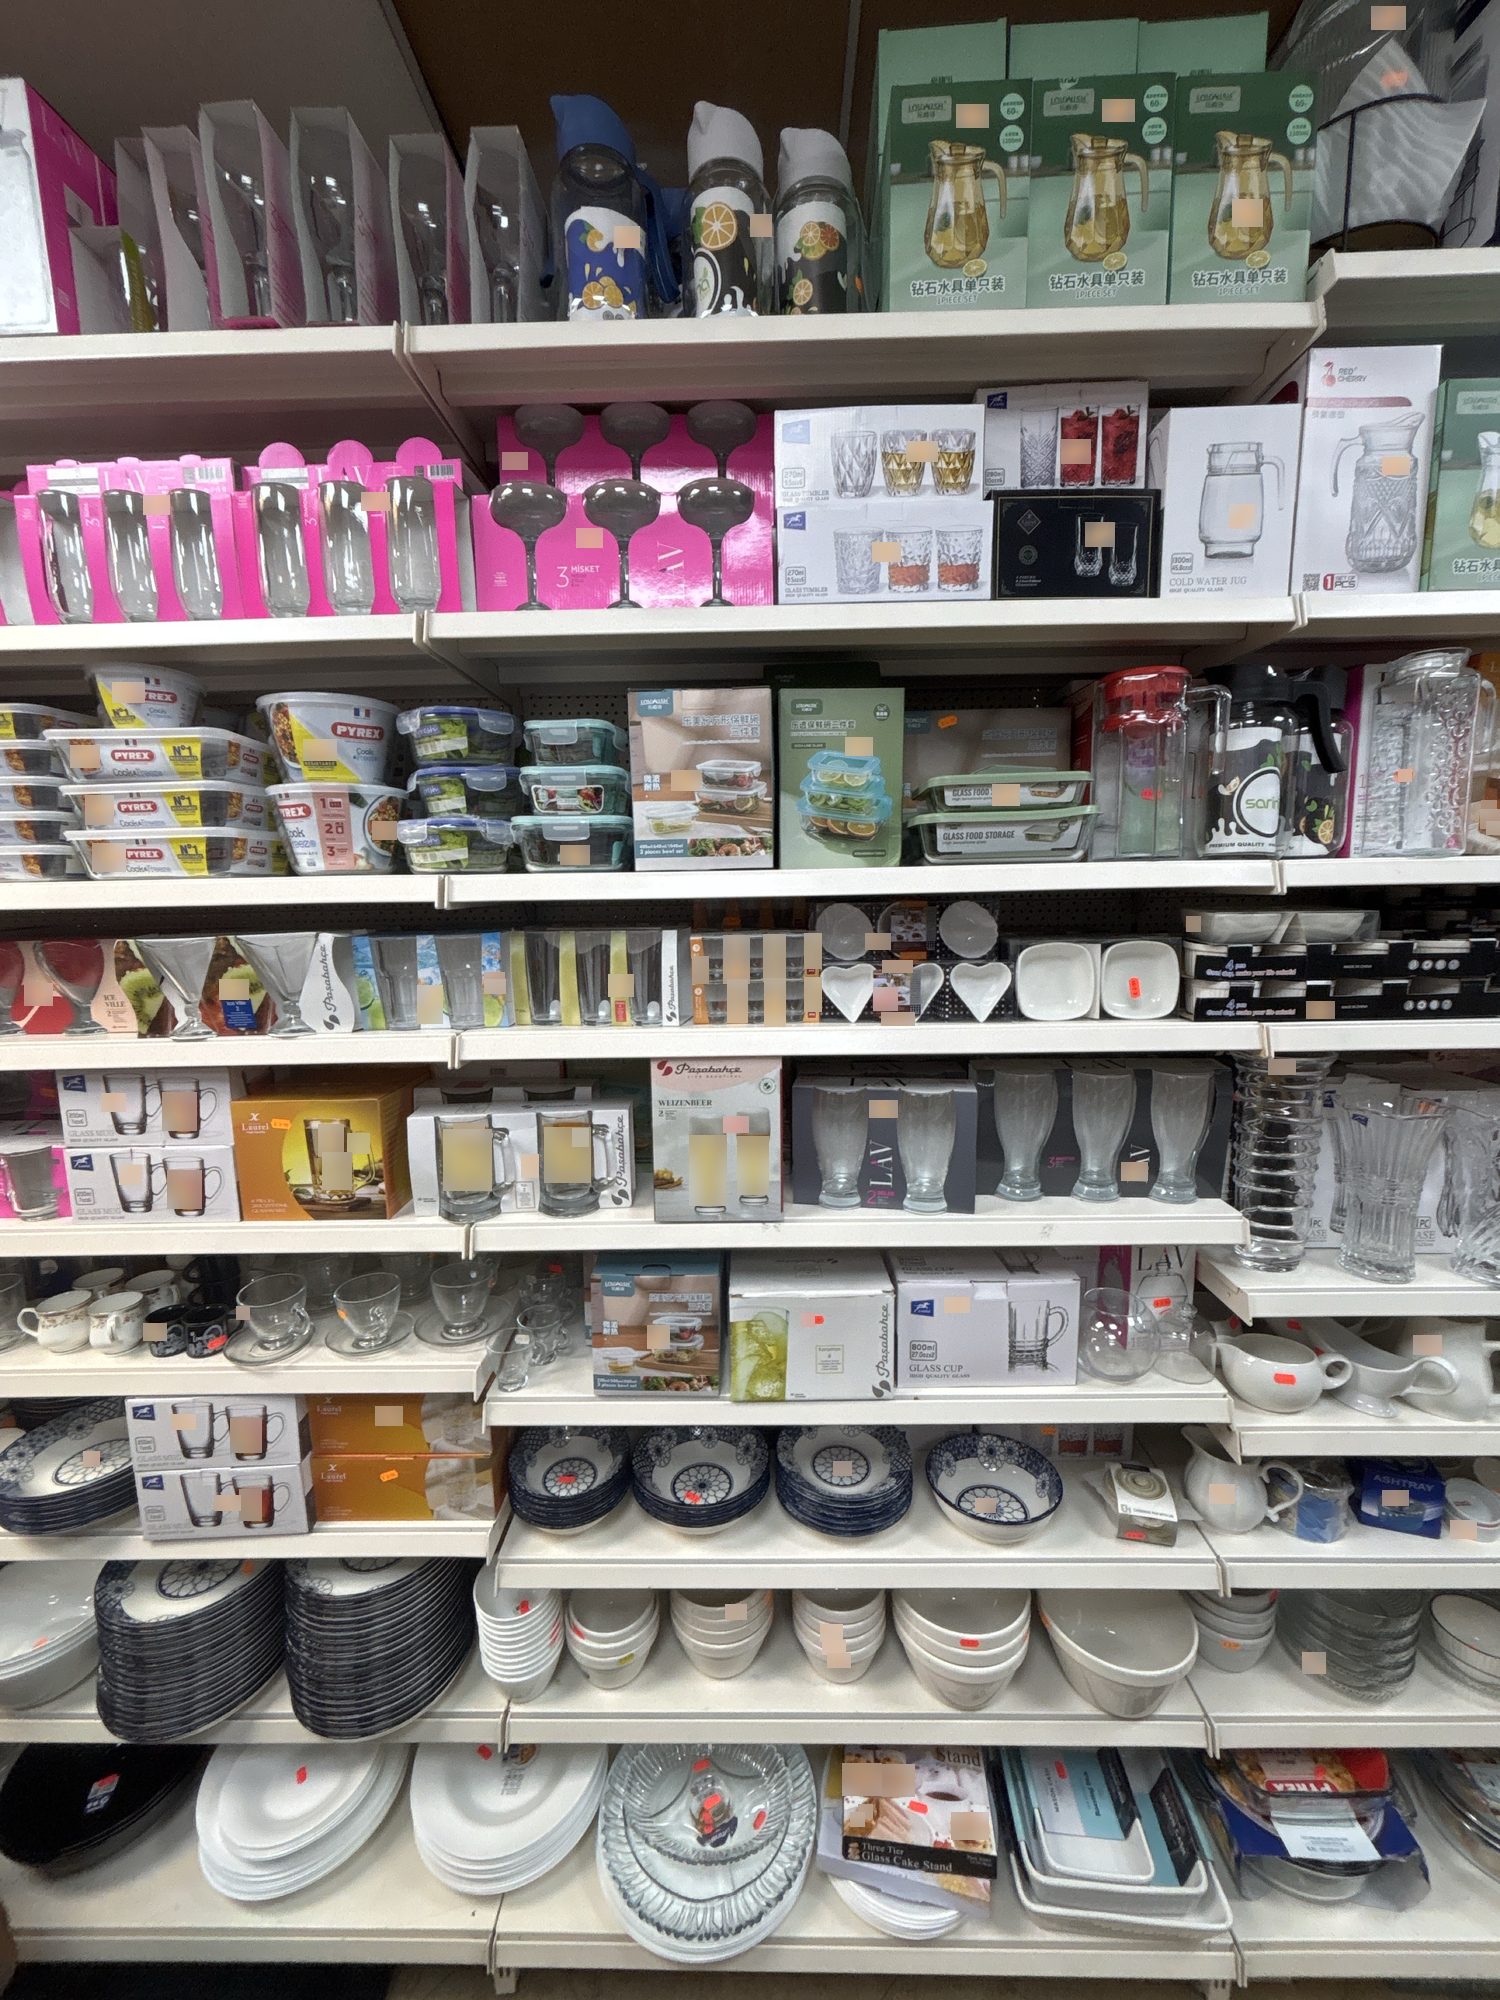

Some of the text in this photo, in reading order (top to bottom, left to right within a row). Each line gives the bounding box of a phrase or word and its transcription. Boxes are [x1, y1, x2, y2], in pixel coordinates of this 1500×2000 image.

[1050, 269, 1144, 290] 钻石水具单只装
[1193, 268, 1287, 288] 钻石水具单只装
[911, 276, 1004, 296] 钻石水具单只装
[556, 566, 569, 588] 3
[1169, 576, 1247, 586] COLD WATER JUG
[1334, 580, 1356, 588] PCS
[336, 726, 380, 740] PYREX
[114, 751, 150, 760] PYREX
[952, 788, 972, 797] GLASS
[120, 803, 153, 812] PYREX
[325, 824, 333, 834] 2
[942, 830, 1016, 840] GLASS FOOD STORAGE
[126, 850, 159, 858] PYREX
[327, 846, 335, 856] 3
[1225, 960, 1234, 970] 4
[1226, 999, 1236, 1010] 4
[675, 1062, 742, 1074] Paşabahçe
[242, 1122, 269, 1131] Laurel
[615, 1114, 628, 1187] Paşabahçe
[870, 1139, 893, 1188] LAV
[876, 1304, 890, 1378] Paşabahçe
[909, 1364, 964, 1372] GLASS CUP
[1373, 1474, 1434, 1492] ASHTRAY
[936, 1748, 981, 1767] Stand
[862, 1842, 904, 1854] Three Tier
[862, 1850, 892, 1862] Glass
[893, 1854, 920, 1868] Cake
[923, 1860, 953, 1872] Stand
